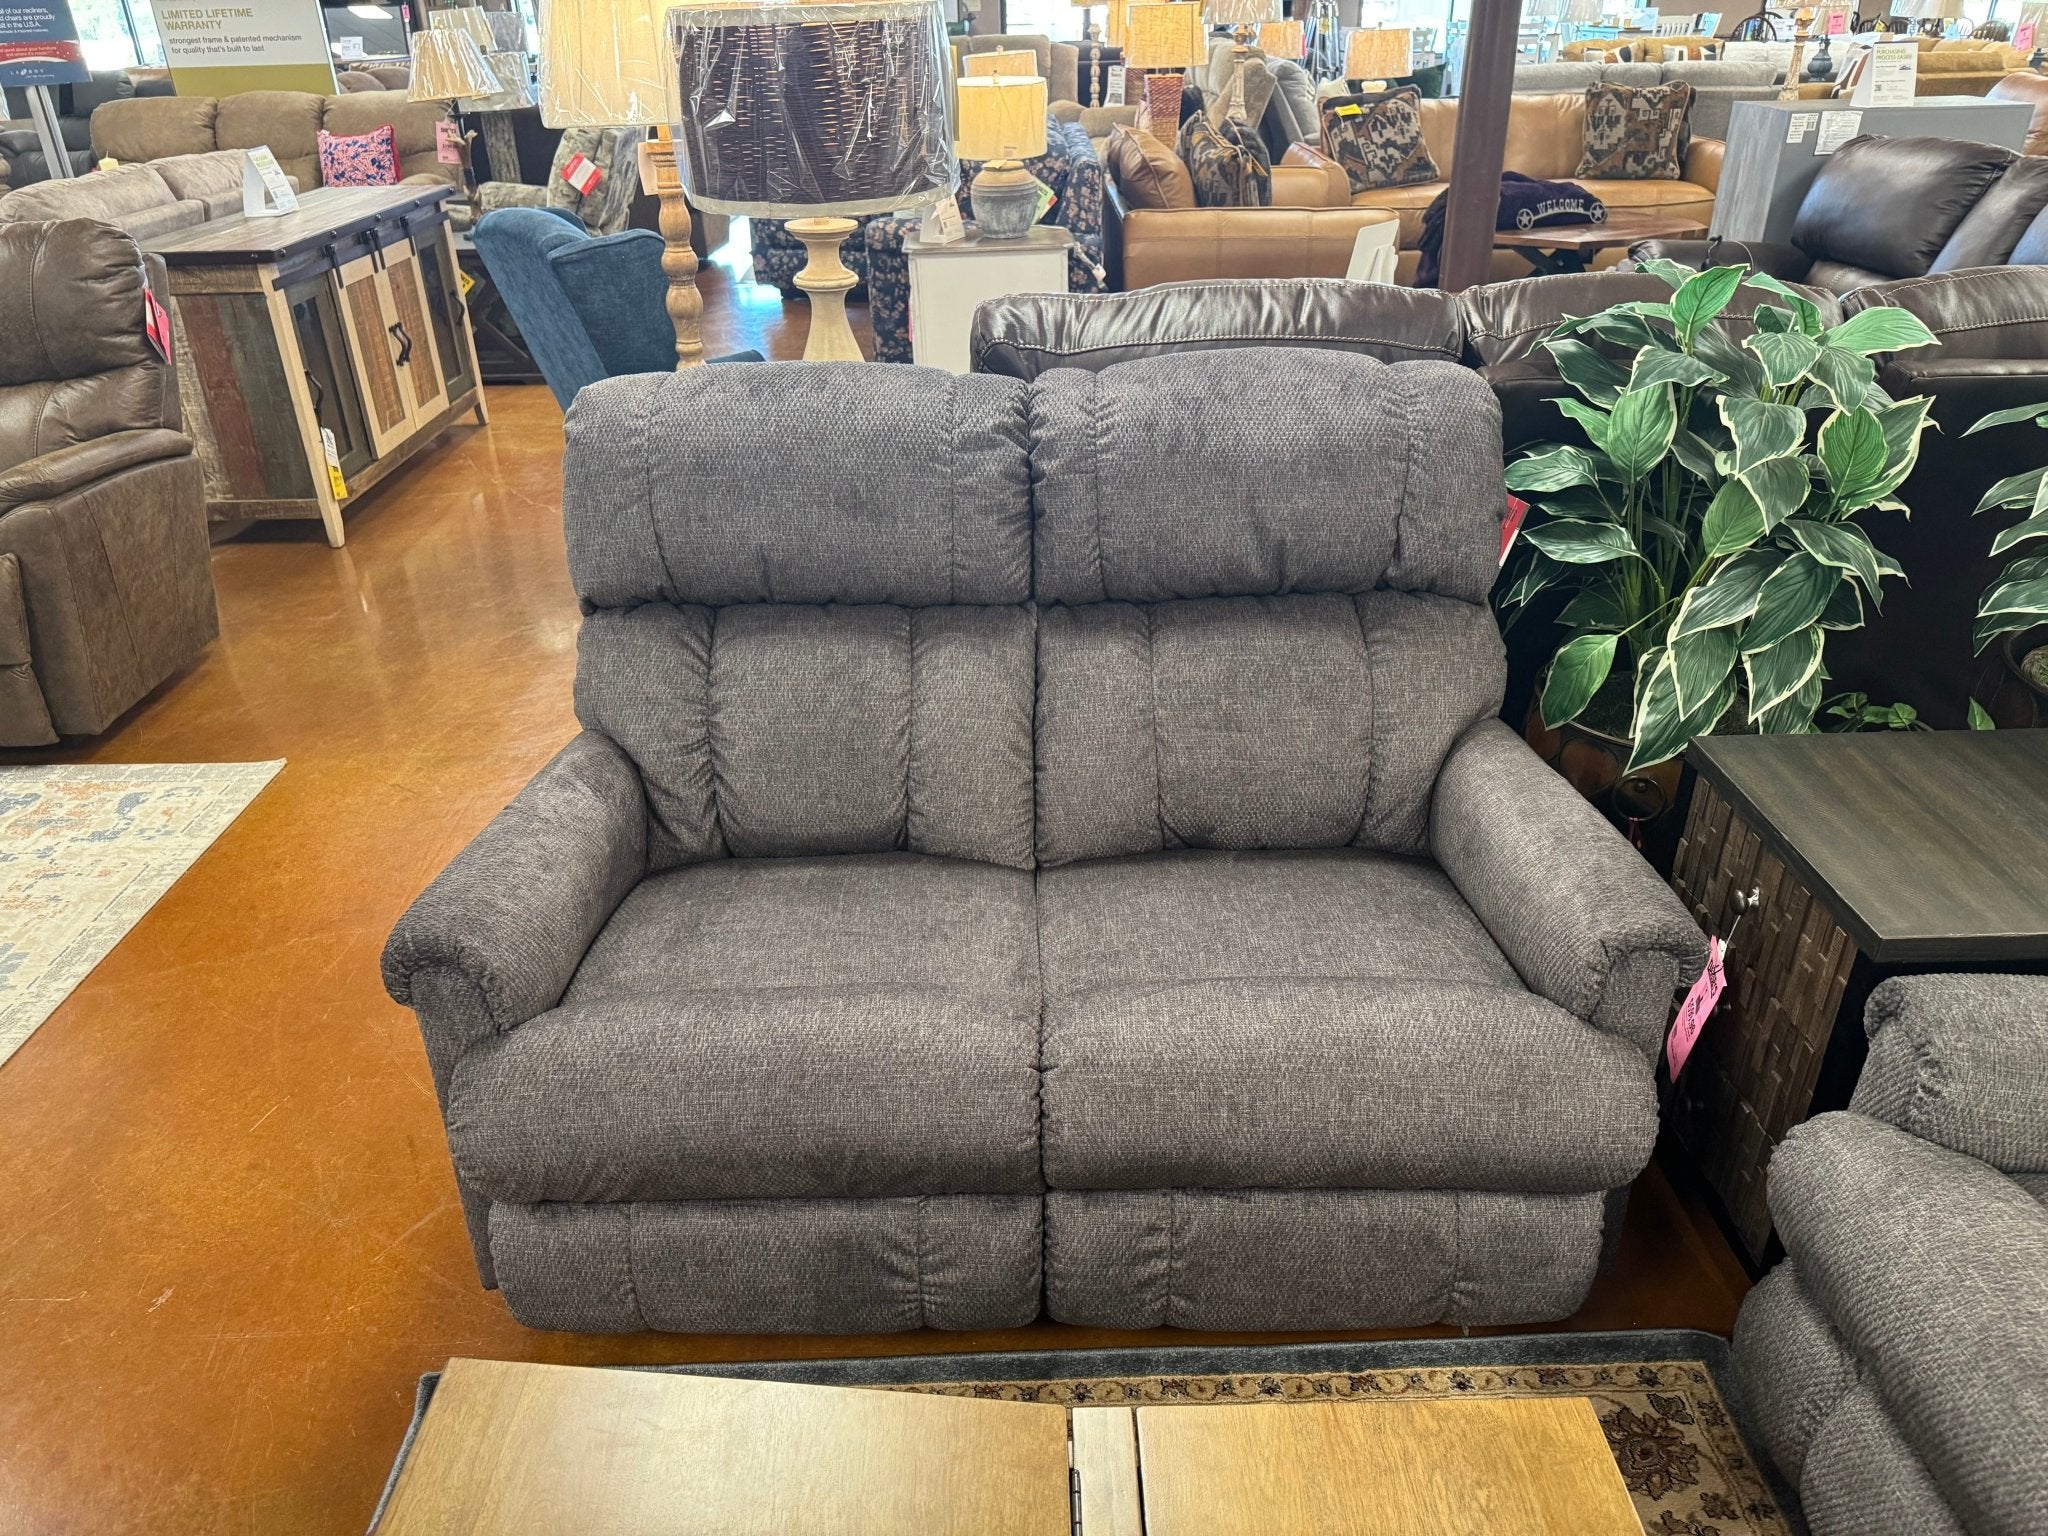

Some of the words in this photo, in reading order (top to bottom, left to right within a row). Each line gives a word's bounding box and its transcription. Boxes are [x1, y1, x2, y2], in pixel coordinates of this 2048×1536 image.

[161, 9, 203, 20] LIMITED
[205, 8, 254, 18] LIFETIME
[164, 20, 222, 30] WARRANTY
[169, 37, 201, 45] strongest
[223, 35, 230, 43] &
[230, 35, 262, 43] patented
[262, 34, 302, 42] mechanism
[182, 46, 206, 54] quality
[1537, 198, 1584, 214] WELCOME
